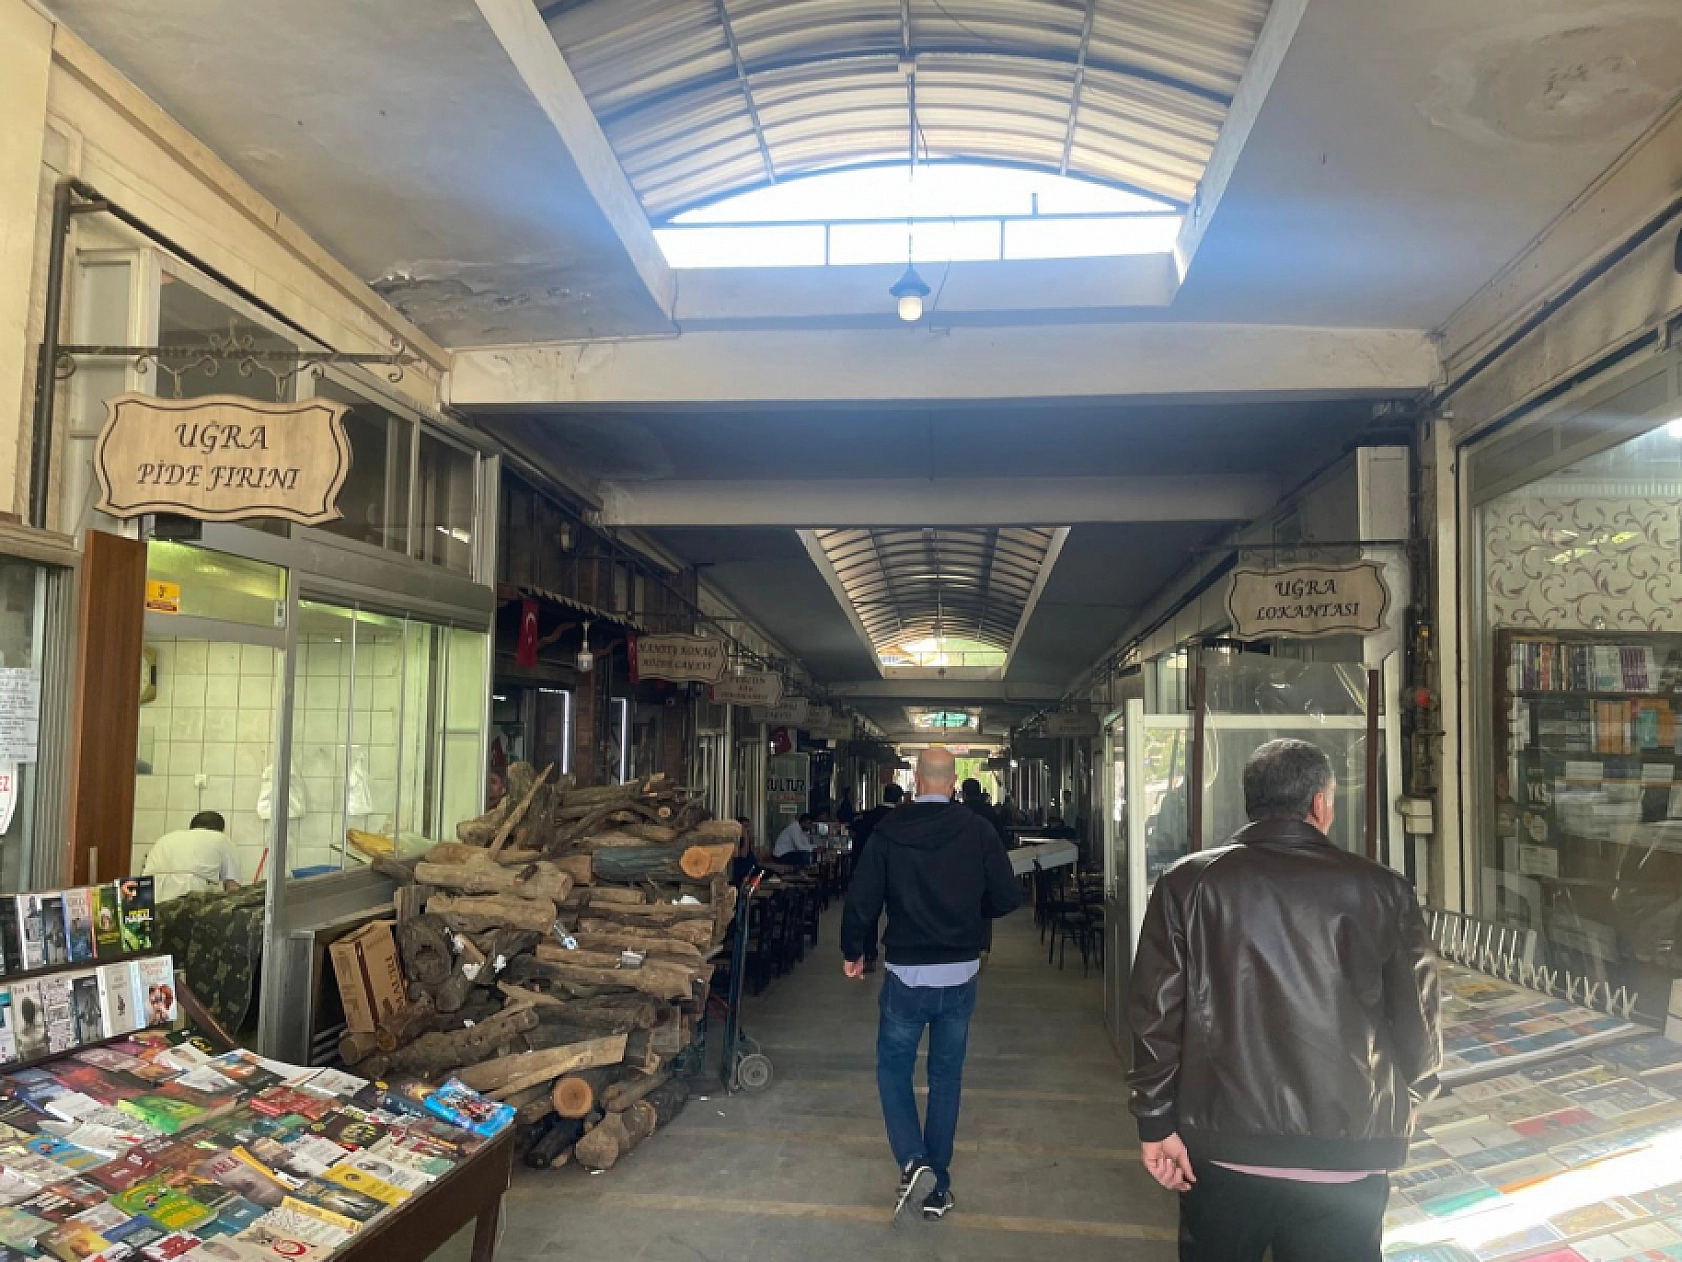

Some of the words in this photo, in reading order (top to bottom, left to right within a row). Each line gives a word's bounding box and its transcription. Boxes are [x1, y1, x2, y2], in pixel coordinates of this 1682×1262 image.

[175, 420, 268, 454] UĞRA
[137, 460, 202, 486] PİDE
[206, 466, 300, 491] FIRINI
[1256, 603, 1360, 621] LOKANTASI
